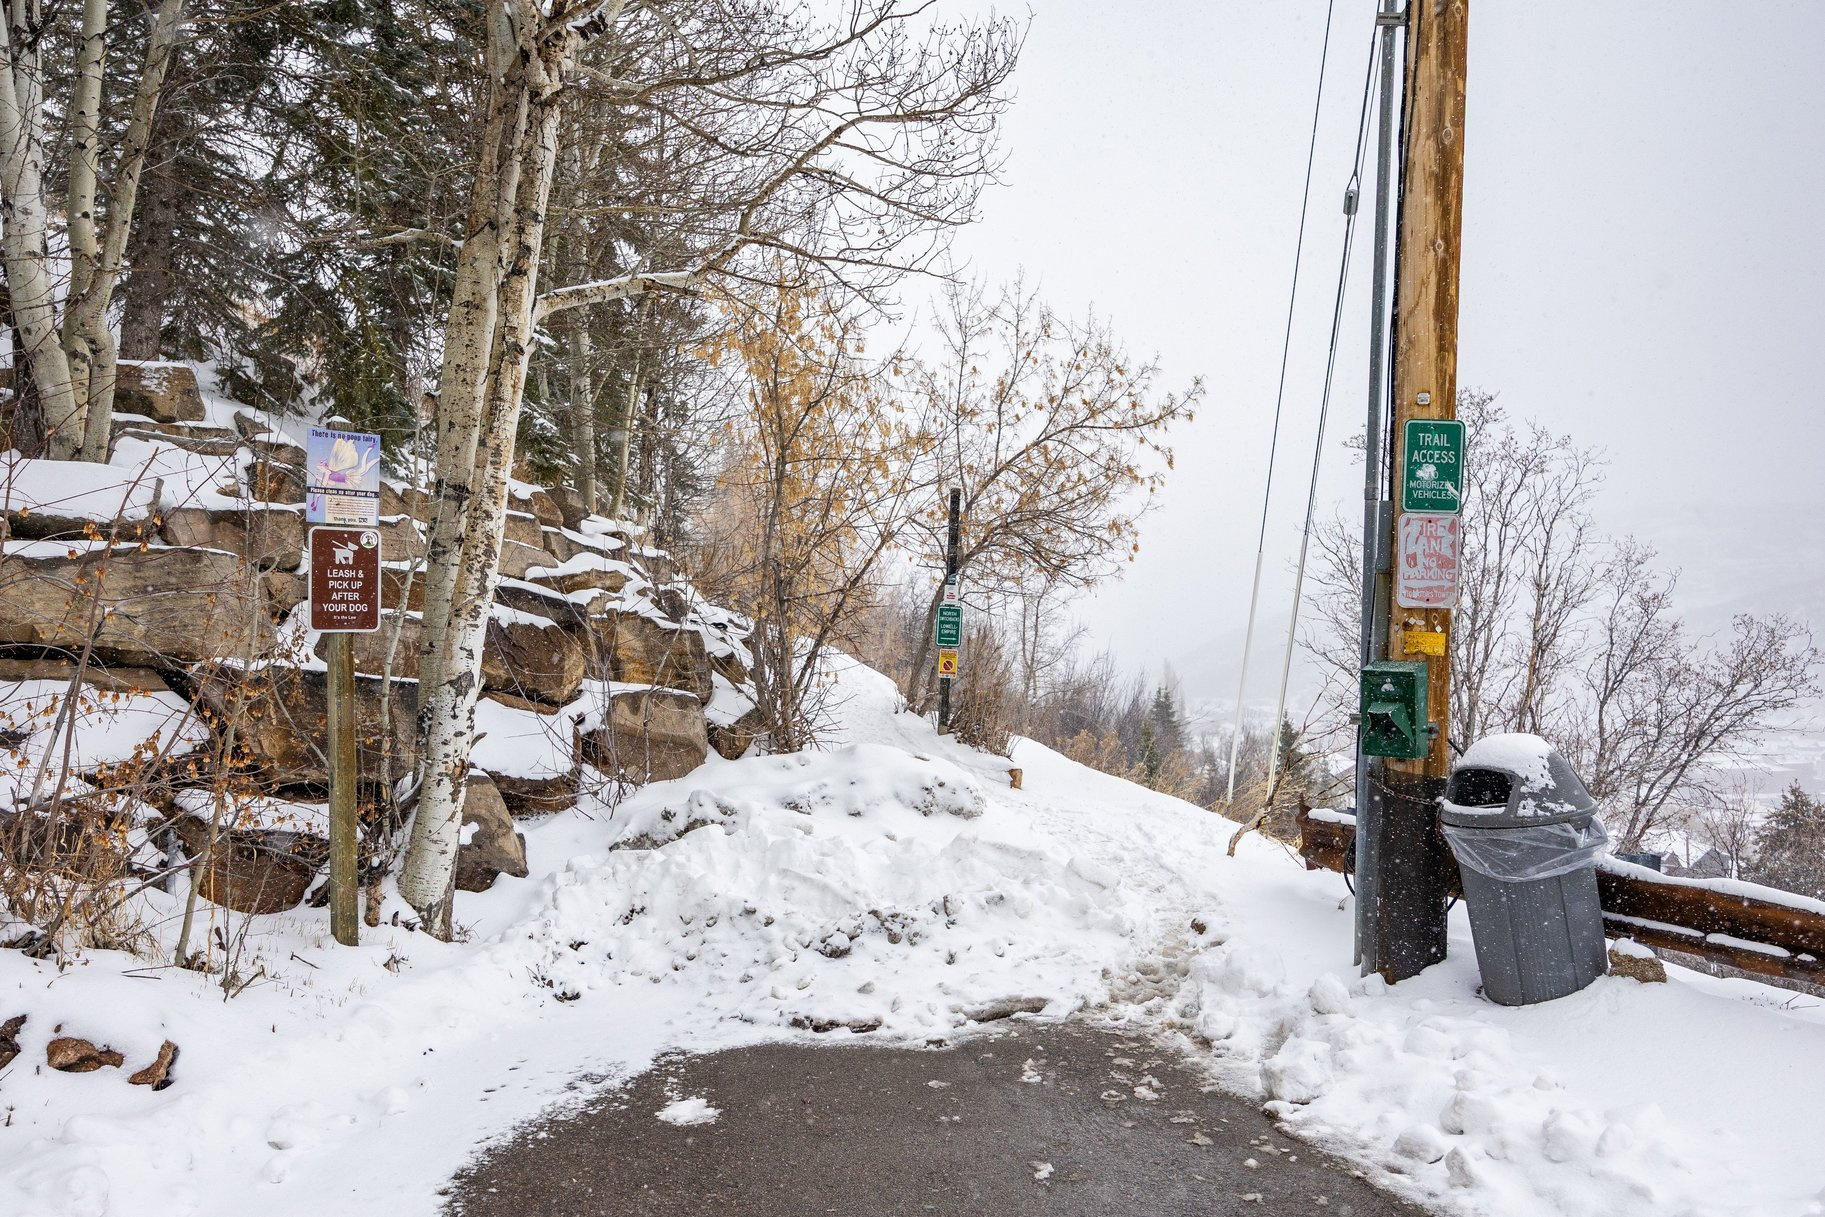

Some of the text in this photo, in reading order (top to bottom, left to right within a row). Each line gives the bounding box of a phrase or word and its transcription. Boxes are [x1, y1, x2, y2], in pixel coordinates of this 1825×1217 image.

[312, 430, 329, 438] There
[347, 434, 361, 442] poop
[1418, 433, 1451, 447] TRAIL
[1412, 449, 1455, 463] ACCESS
[1409, 480, 1456, 489] MOTORIZED
[1412, 490, 1452, 499] VEHICLES
[327, 569, 364, 578] LEASH &
[328, 580, 363, 590] PICK UP
[331, 592, 360, 601] AFTER
[322, 603, 368, 612] YOUR DOG
